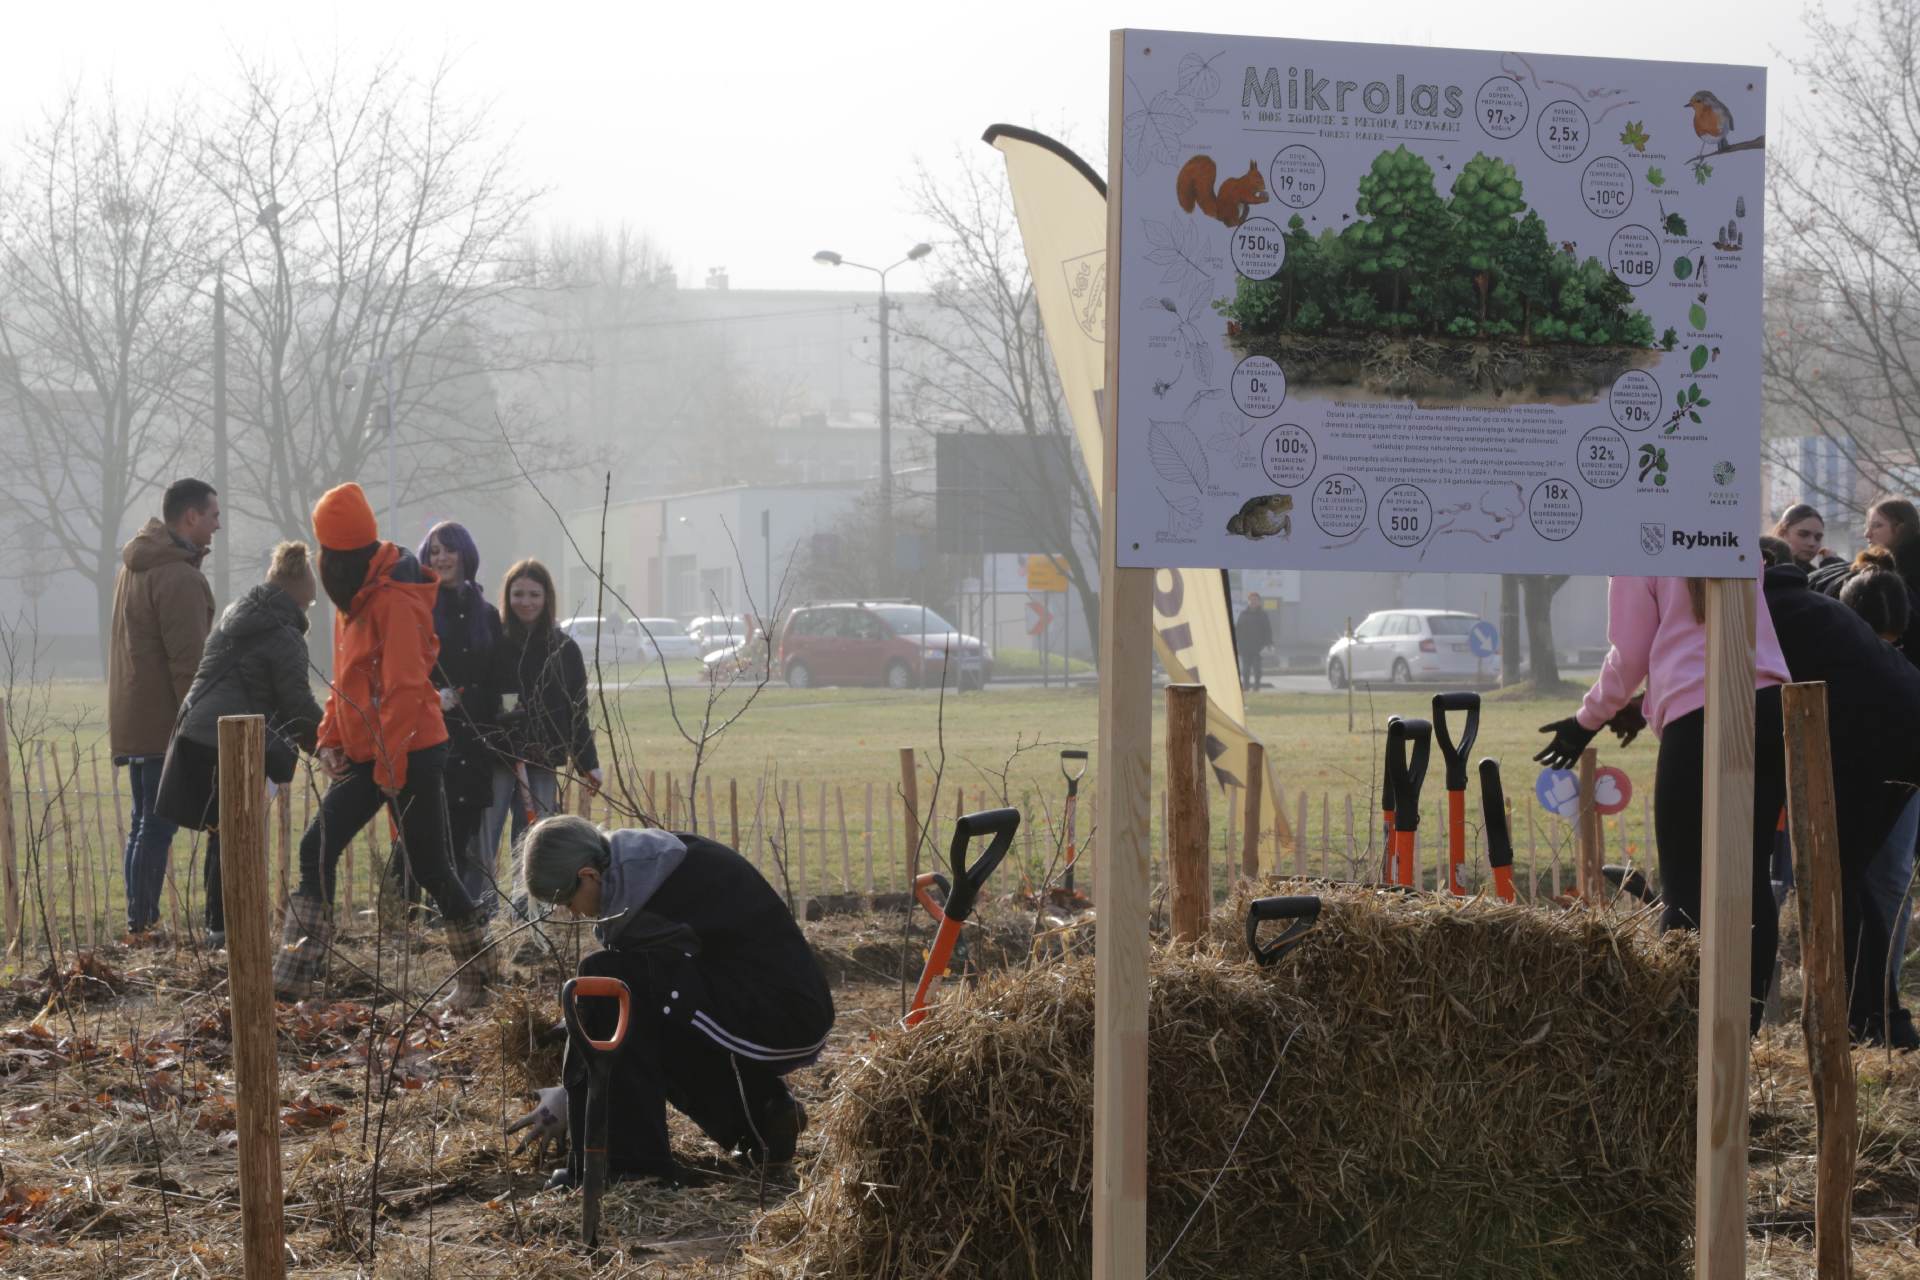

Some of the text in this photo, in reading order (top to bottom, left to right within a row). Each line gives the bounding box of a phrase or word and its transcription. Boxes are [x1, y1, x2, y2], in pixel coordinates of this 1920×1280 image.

[1241, 66, 1463, 118] Mikrolas
[1549, 126, 1578, 142] 2,5x
[1280, 176, 1316, 191] 19 ton
[1239, 236, 1279, 254] 750kg
[1612, 260, 1654, 274] -10dB
[1250, 378, 1268, 392] 0%
[1626, 406, 1650, 421] 90%
[1276, 438, 1308, 454] 100%
[1590, 446, 1614, 460] 32%
[1545, 484, 1568, 500] 18x
[1392, 516, 1418, 531] 500
[1672, 530, 1739, 549] Rybnik
